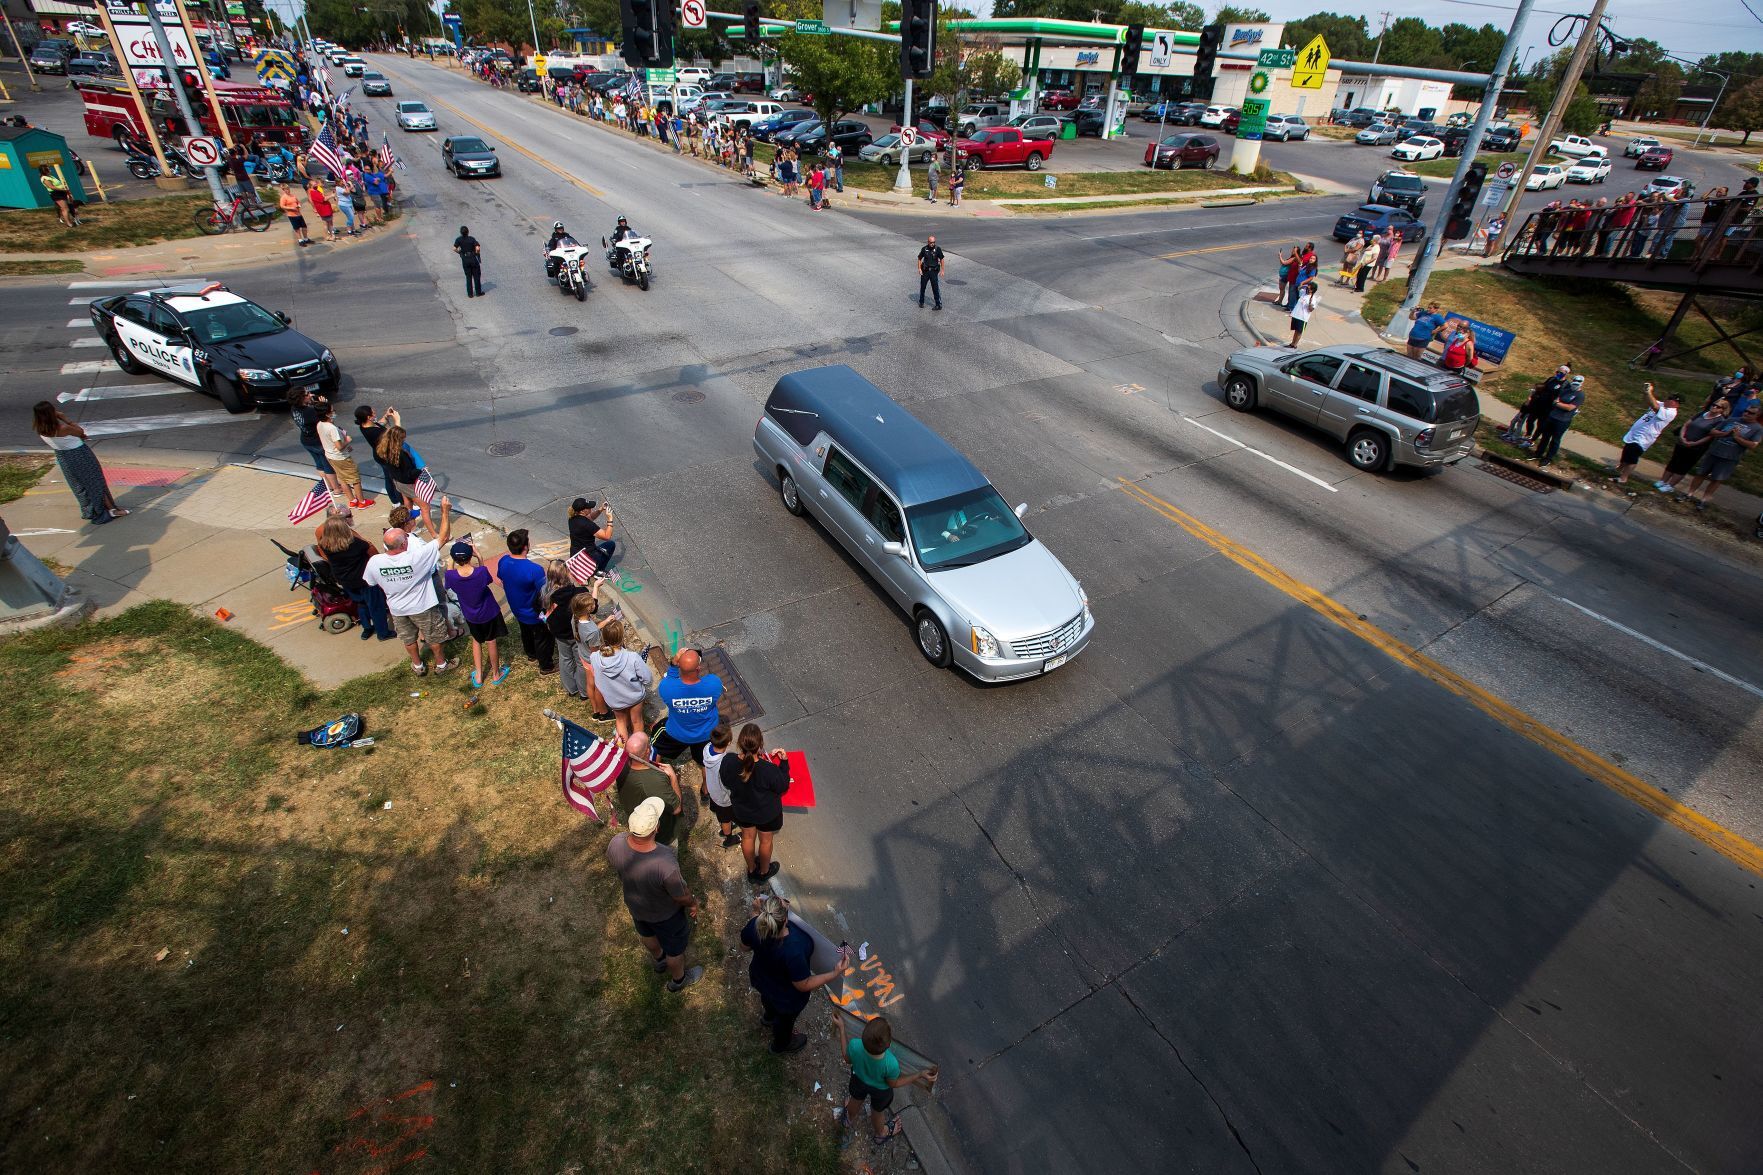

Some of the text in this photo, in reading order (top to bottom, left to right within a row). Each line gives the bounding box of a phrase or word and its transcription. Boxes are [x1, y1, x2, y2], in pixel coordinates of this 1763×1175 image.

[797, 21, 818, 31] Grover
[130, 40, 187, 59] CHIA
[1153, 57, 1167, 65] ONLY
[1280, 53, 1291, 65] St
[130, 338, 181, 367] POLICE
[381, 567, 411, 576] CHOPS
